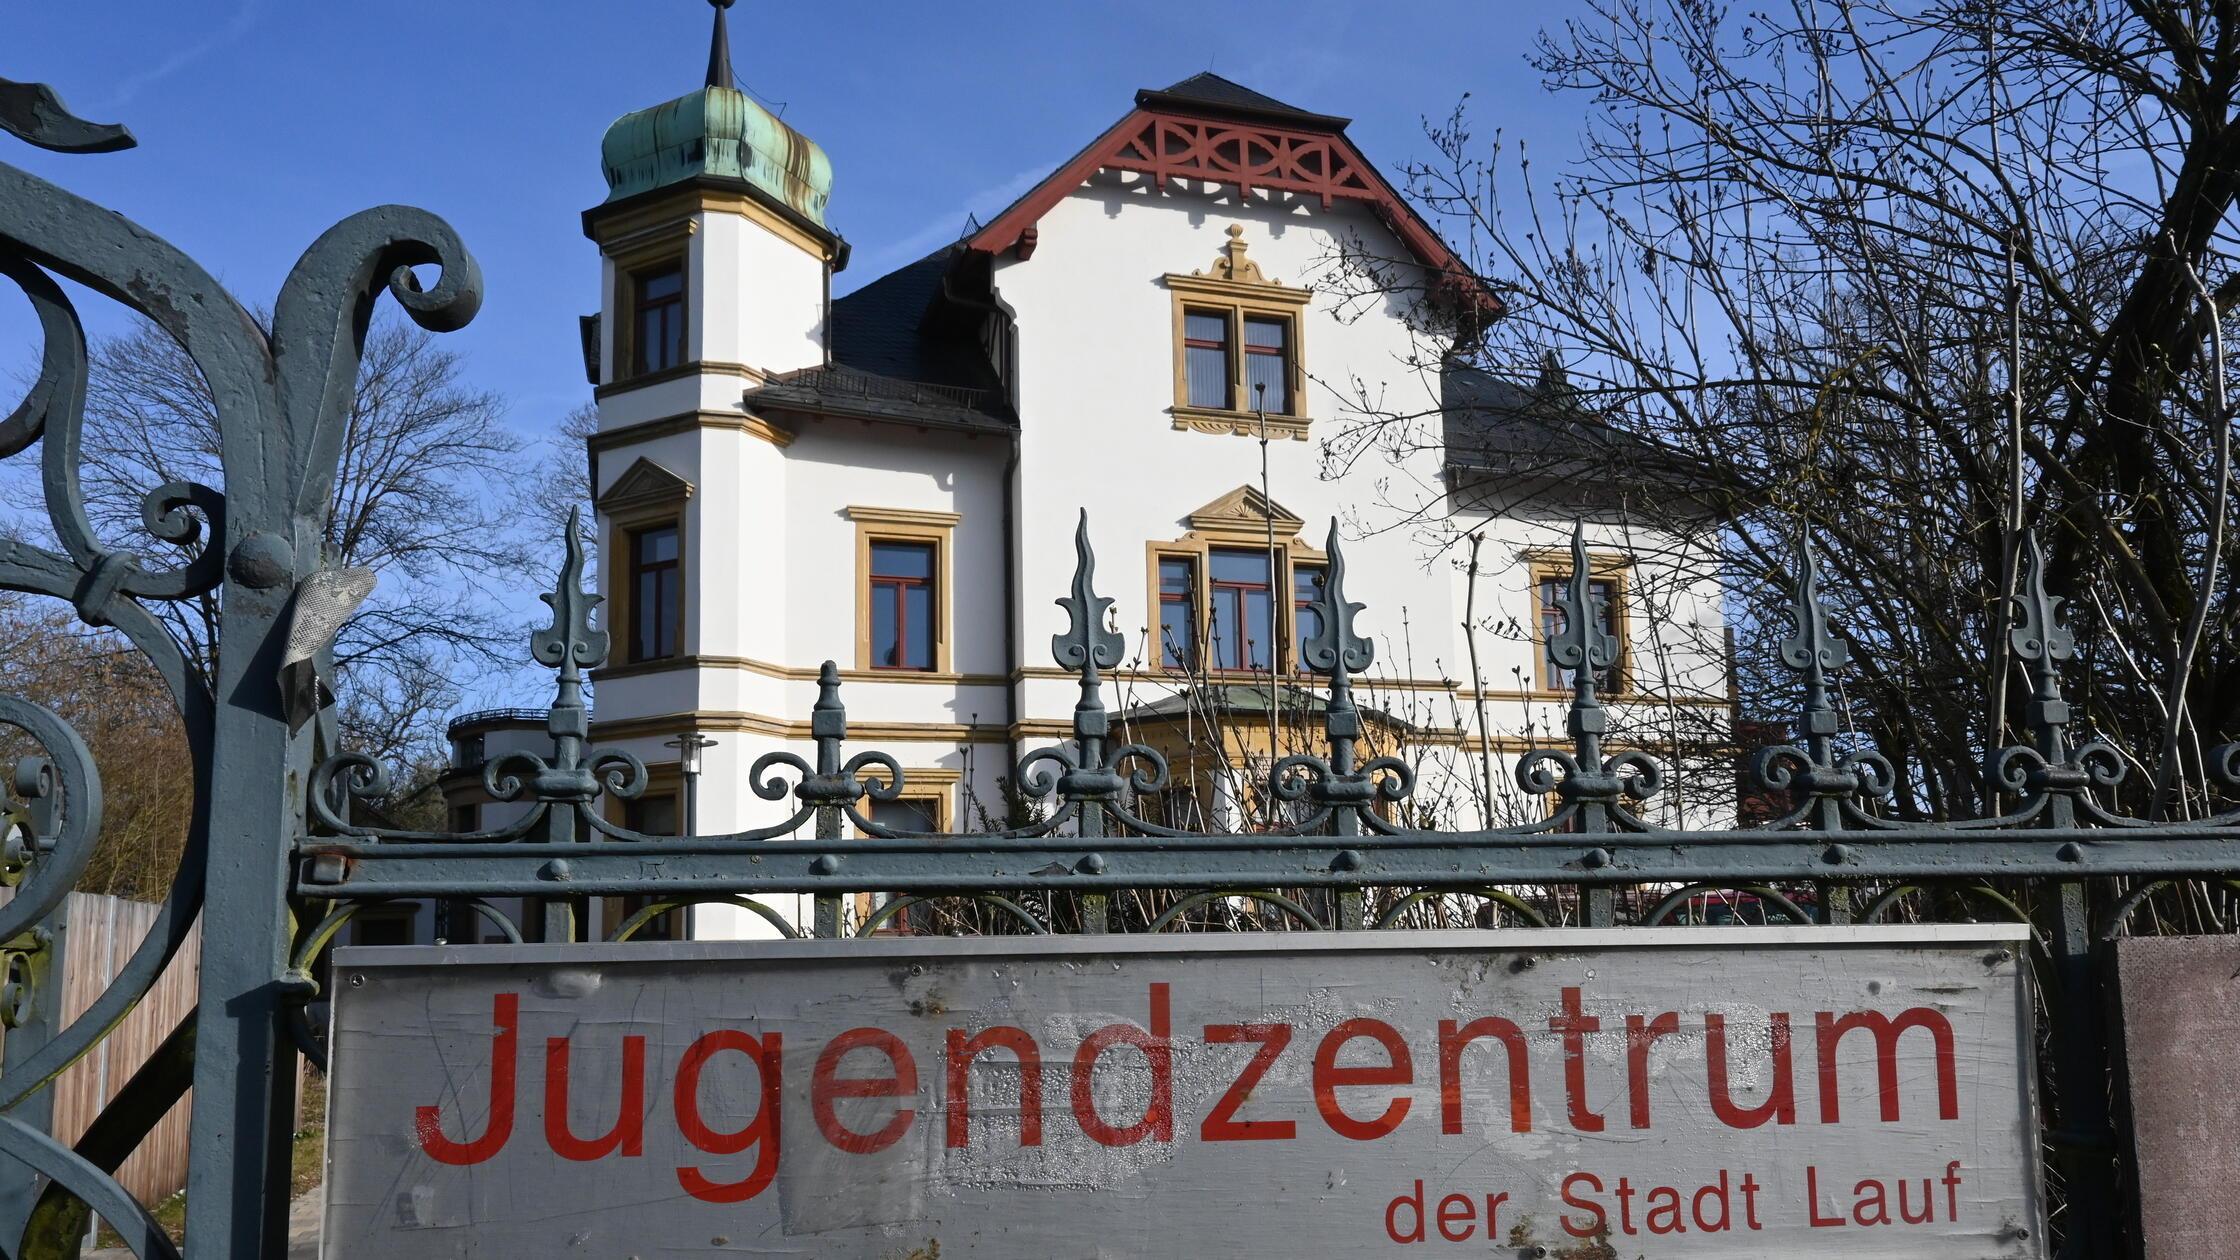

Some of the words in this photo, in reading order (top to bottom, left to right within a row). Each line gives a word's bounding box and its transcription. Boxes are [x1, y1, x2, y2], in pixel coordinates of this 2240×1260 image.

[416, 983, 1959, 1205] Jugendzentrum
[1386, 1178, 1509, 1244] der
[1561, 1169, 1763, 1239] Stadt
[1806, 1160, 1961, 1228] Lauf
